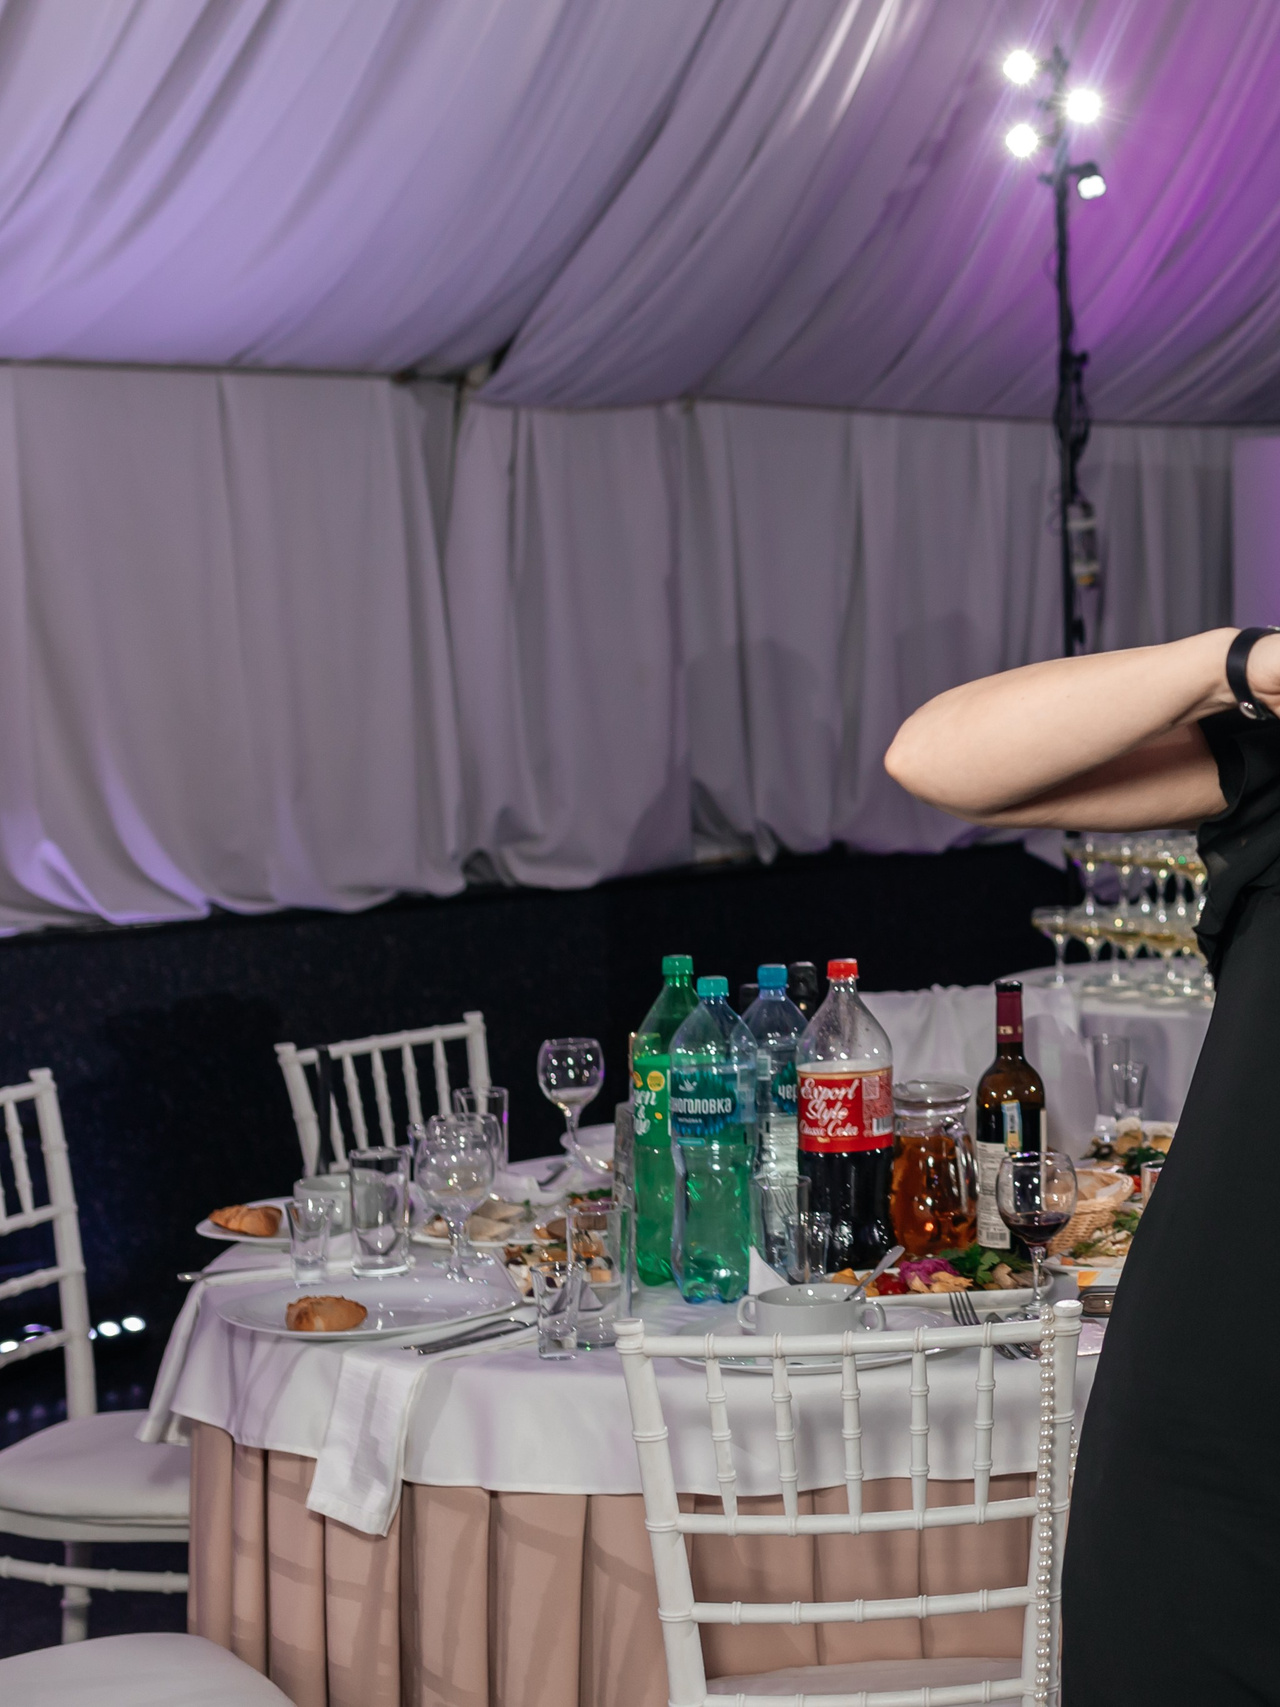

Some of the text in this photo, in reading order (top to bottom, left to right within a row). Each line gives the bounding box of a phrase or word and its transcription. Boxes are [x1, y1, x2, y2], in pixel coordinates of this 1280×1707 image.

[800, 1077, 860, 1105] Export
[805, 1099, 849, 1127] Style
[827, 1119, 859, 1137] Cola
